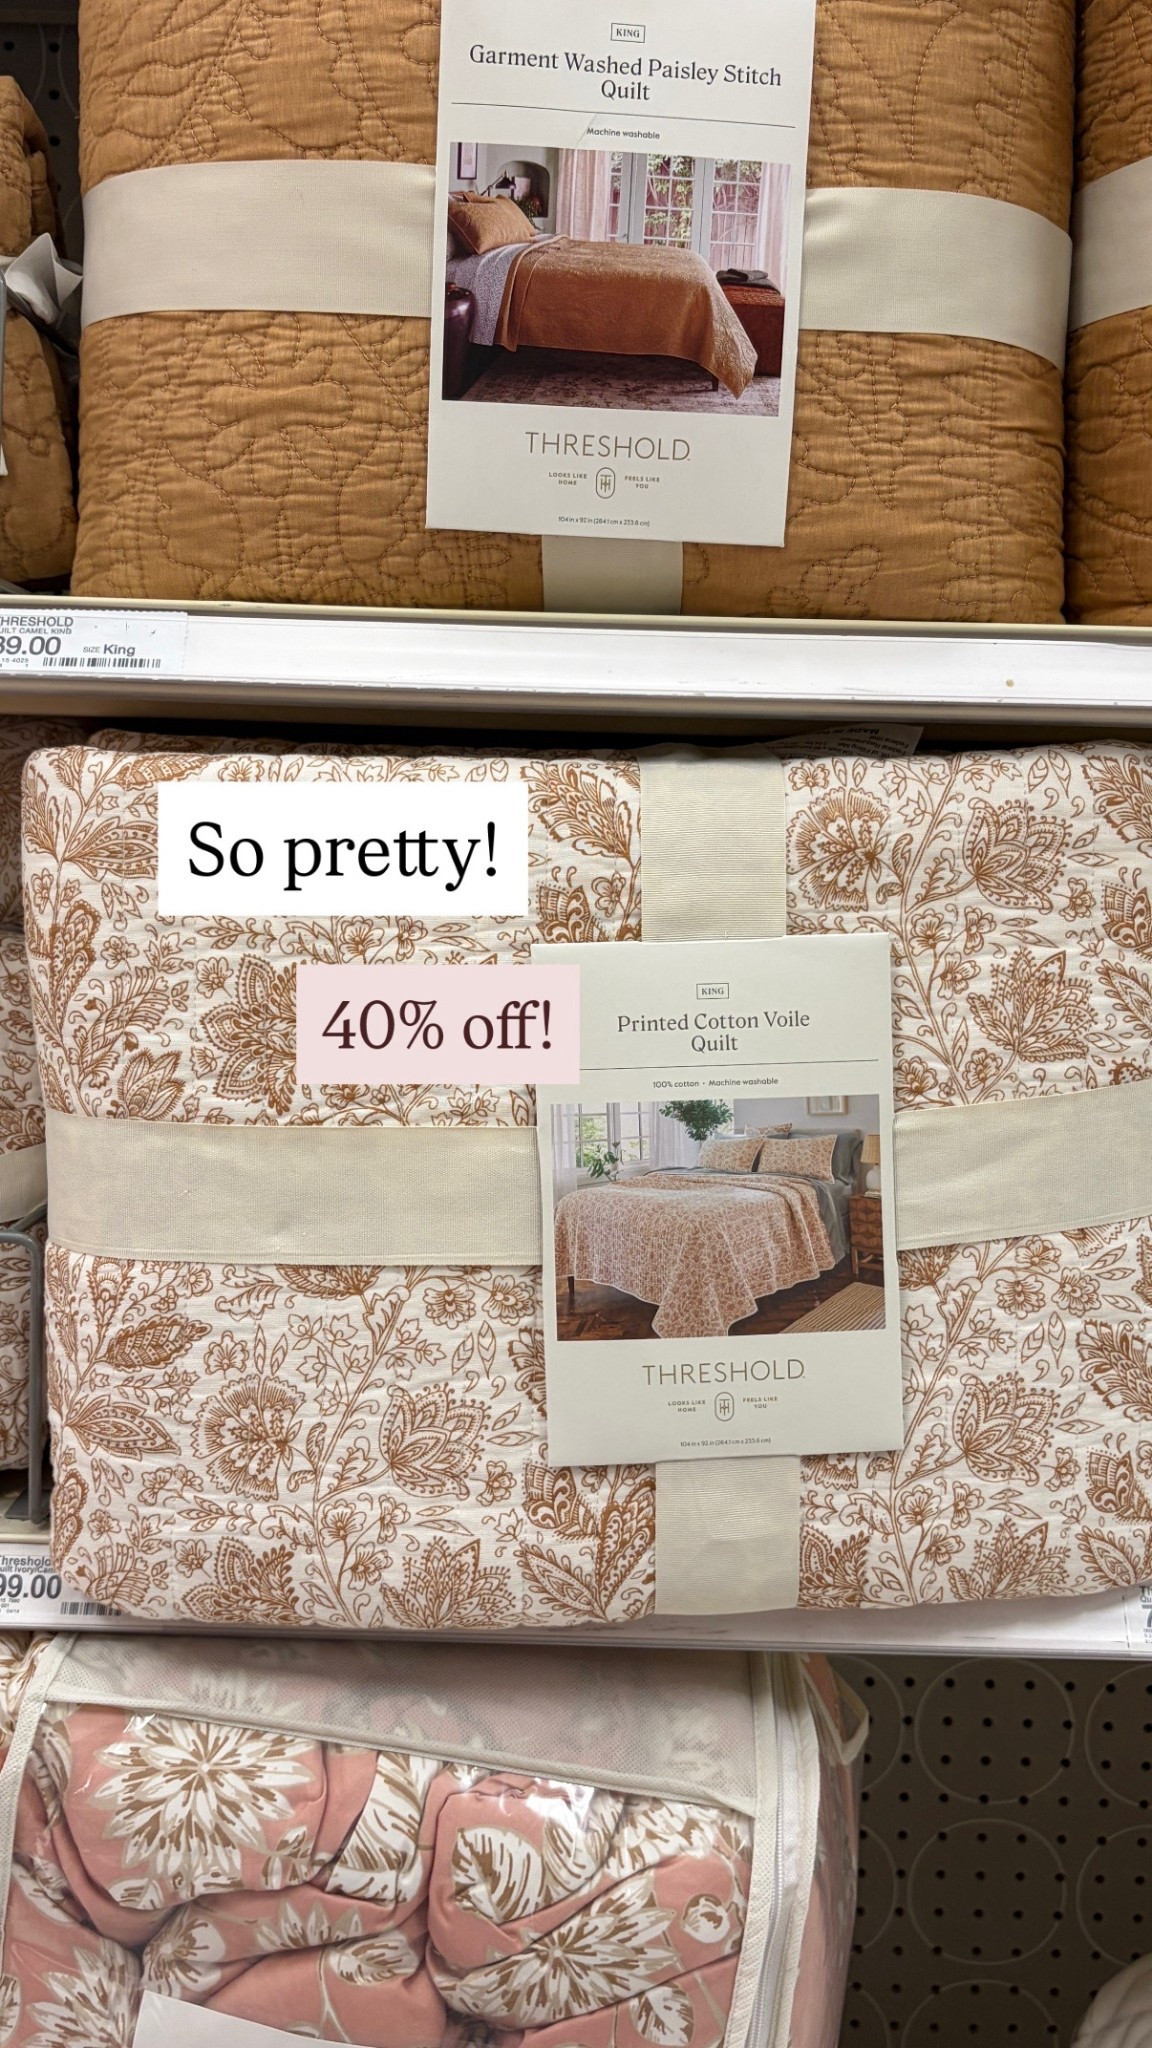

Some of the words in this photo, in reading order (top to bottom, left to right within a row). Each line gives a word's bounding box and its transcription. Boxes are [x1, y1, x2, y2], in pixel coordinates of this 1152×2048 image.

[616, 28, 640, 38] KING
[469, 44, 559, 69] Garment
[564, 52, 642, 76] Washed
[648, 58, 719, 85] Paisley
[723, 64, 782, 86] Stitch
[601, 79, 650, 101] Quilt
[586, 127, 621, 138] Machine
[622, 130, 660, 140] washable
[525, 431, 691, 461] THRESHOLD
[19, 627, 49, 635] CAMEL
[103, 643, 136, 657] King
[701, 987, 724, 996] KING
[617, 1014, 689, 1032] Printed
[694, 1013, 759, 1030] Cotton
[763, 1010, 810, 1028] Voile
[691, 1034, 738, 1054] Quilt
[652, 1080, 673, 1088] 100%
[674, 1080, 699, 1088] cotton
[708, 1078, 741, 1087] Machine
[742, 1077, 779, 1086] washable
[642, 1359, 806, 1385] THRESHOLD
